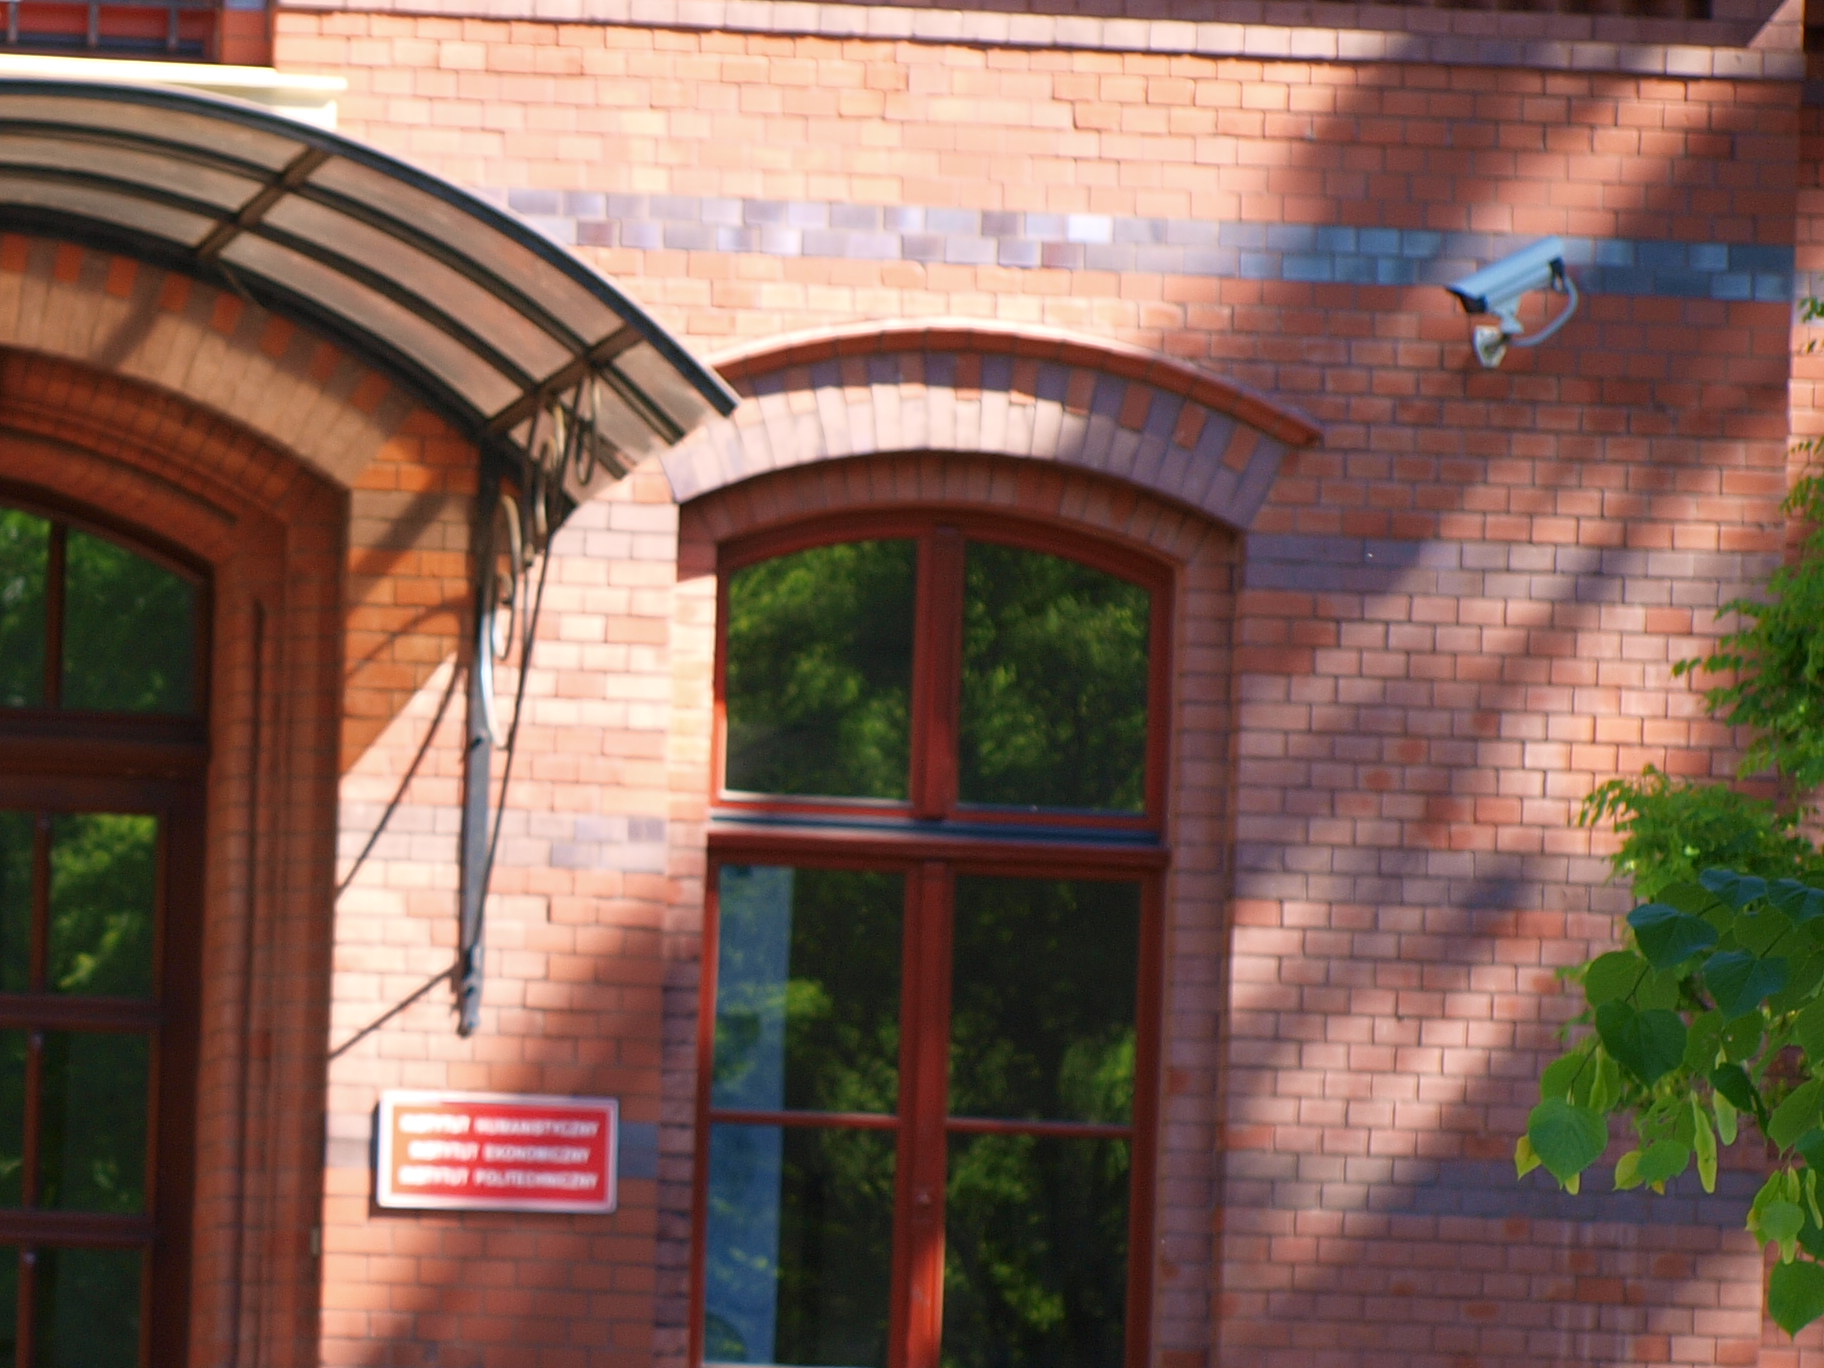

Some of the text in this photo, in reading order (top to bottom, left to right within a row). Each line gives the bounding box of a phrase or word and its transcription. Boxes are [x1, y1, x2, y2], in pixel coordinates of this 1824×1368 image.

[398, 1114, 600, 1136] INSTYTUT HUMANISTYCZNY
[408, 1140, 590, 1164] INSTYTUT EKONOMICZNY
[398, 1165, 598, 1190] INSTYTUT POLITECHNICZNY
